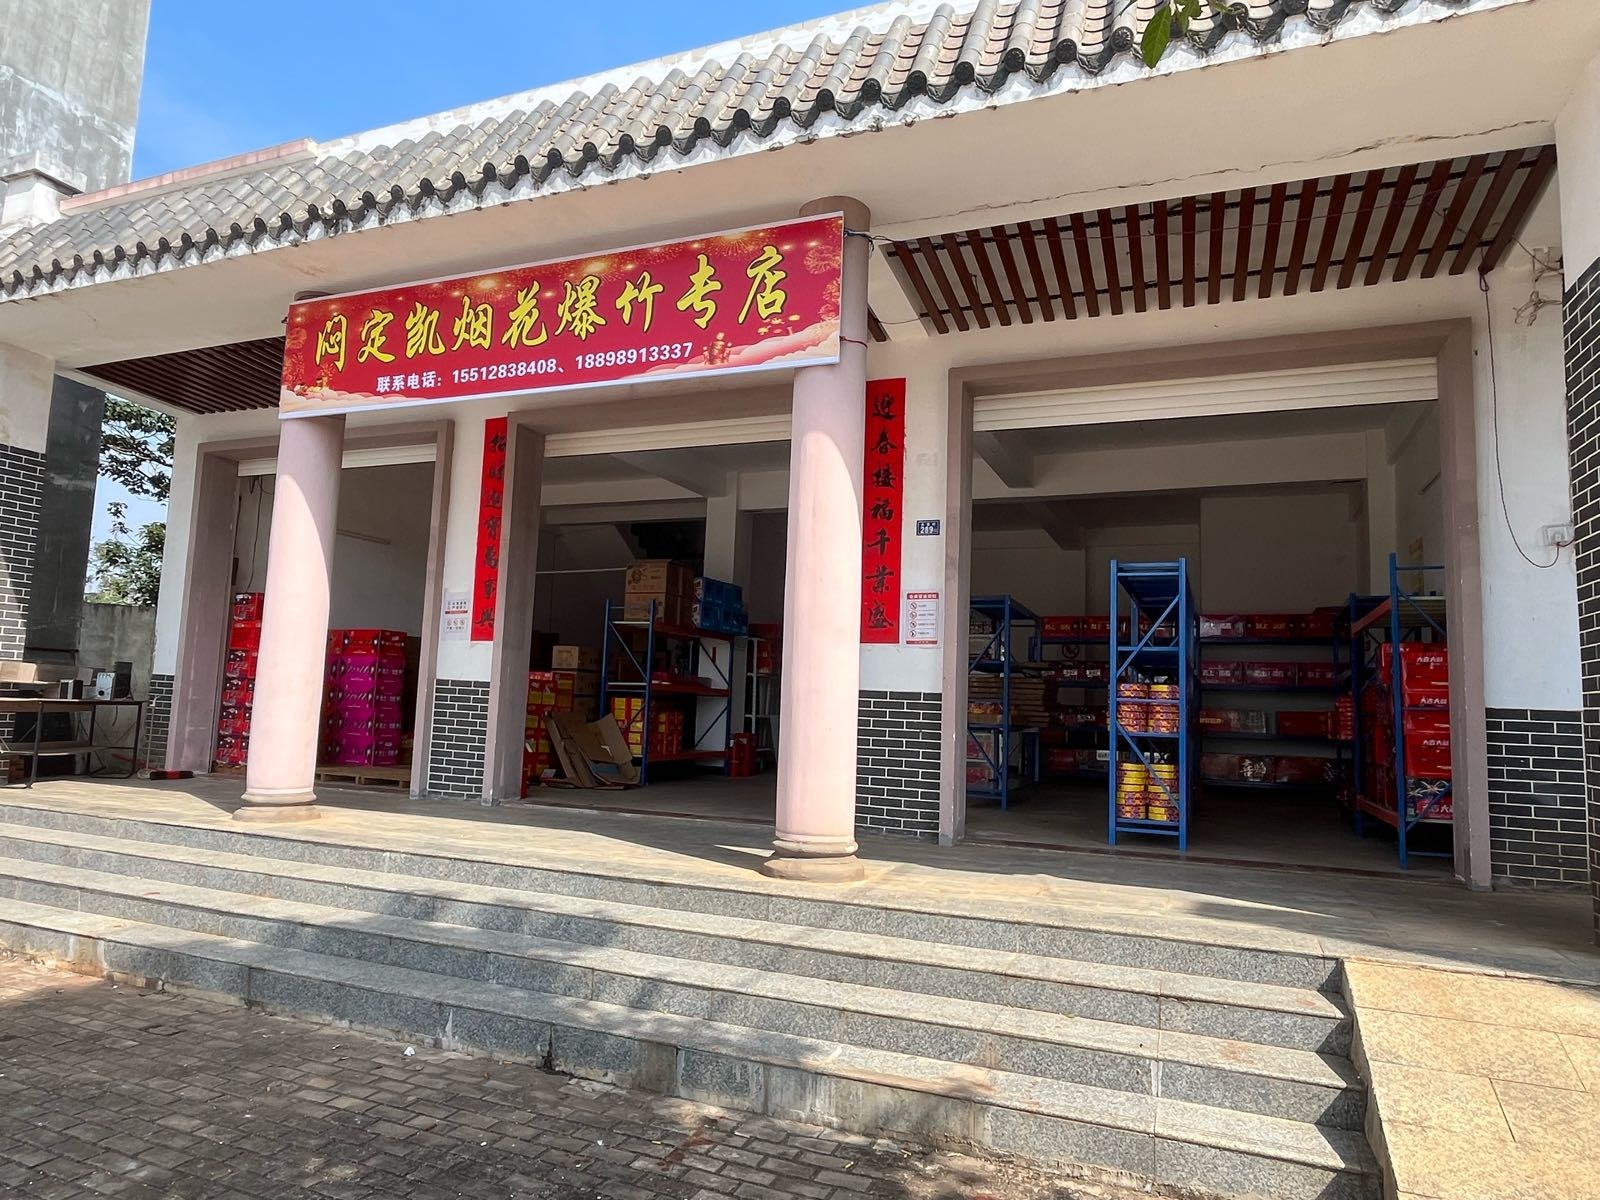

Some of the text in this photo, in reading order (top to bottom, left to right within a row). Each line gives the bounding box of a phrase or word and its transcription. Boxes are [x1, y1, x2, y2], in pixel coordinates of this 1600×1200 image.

[315, 244, 790, 374] 闷定凯烟花爆竹专店
